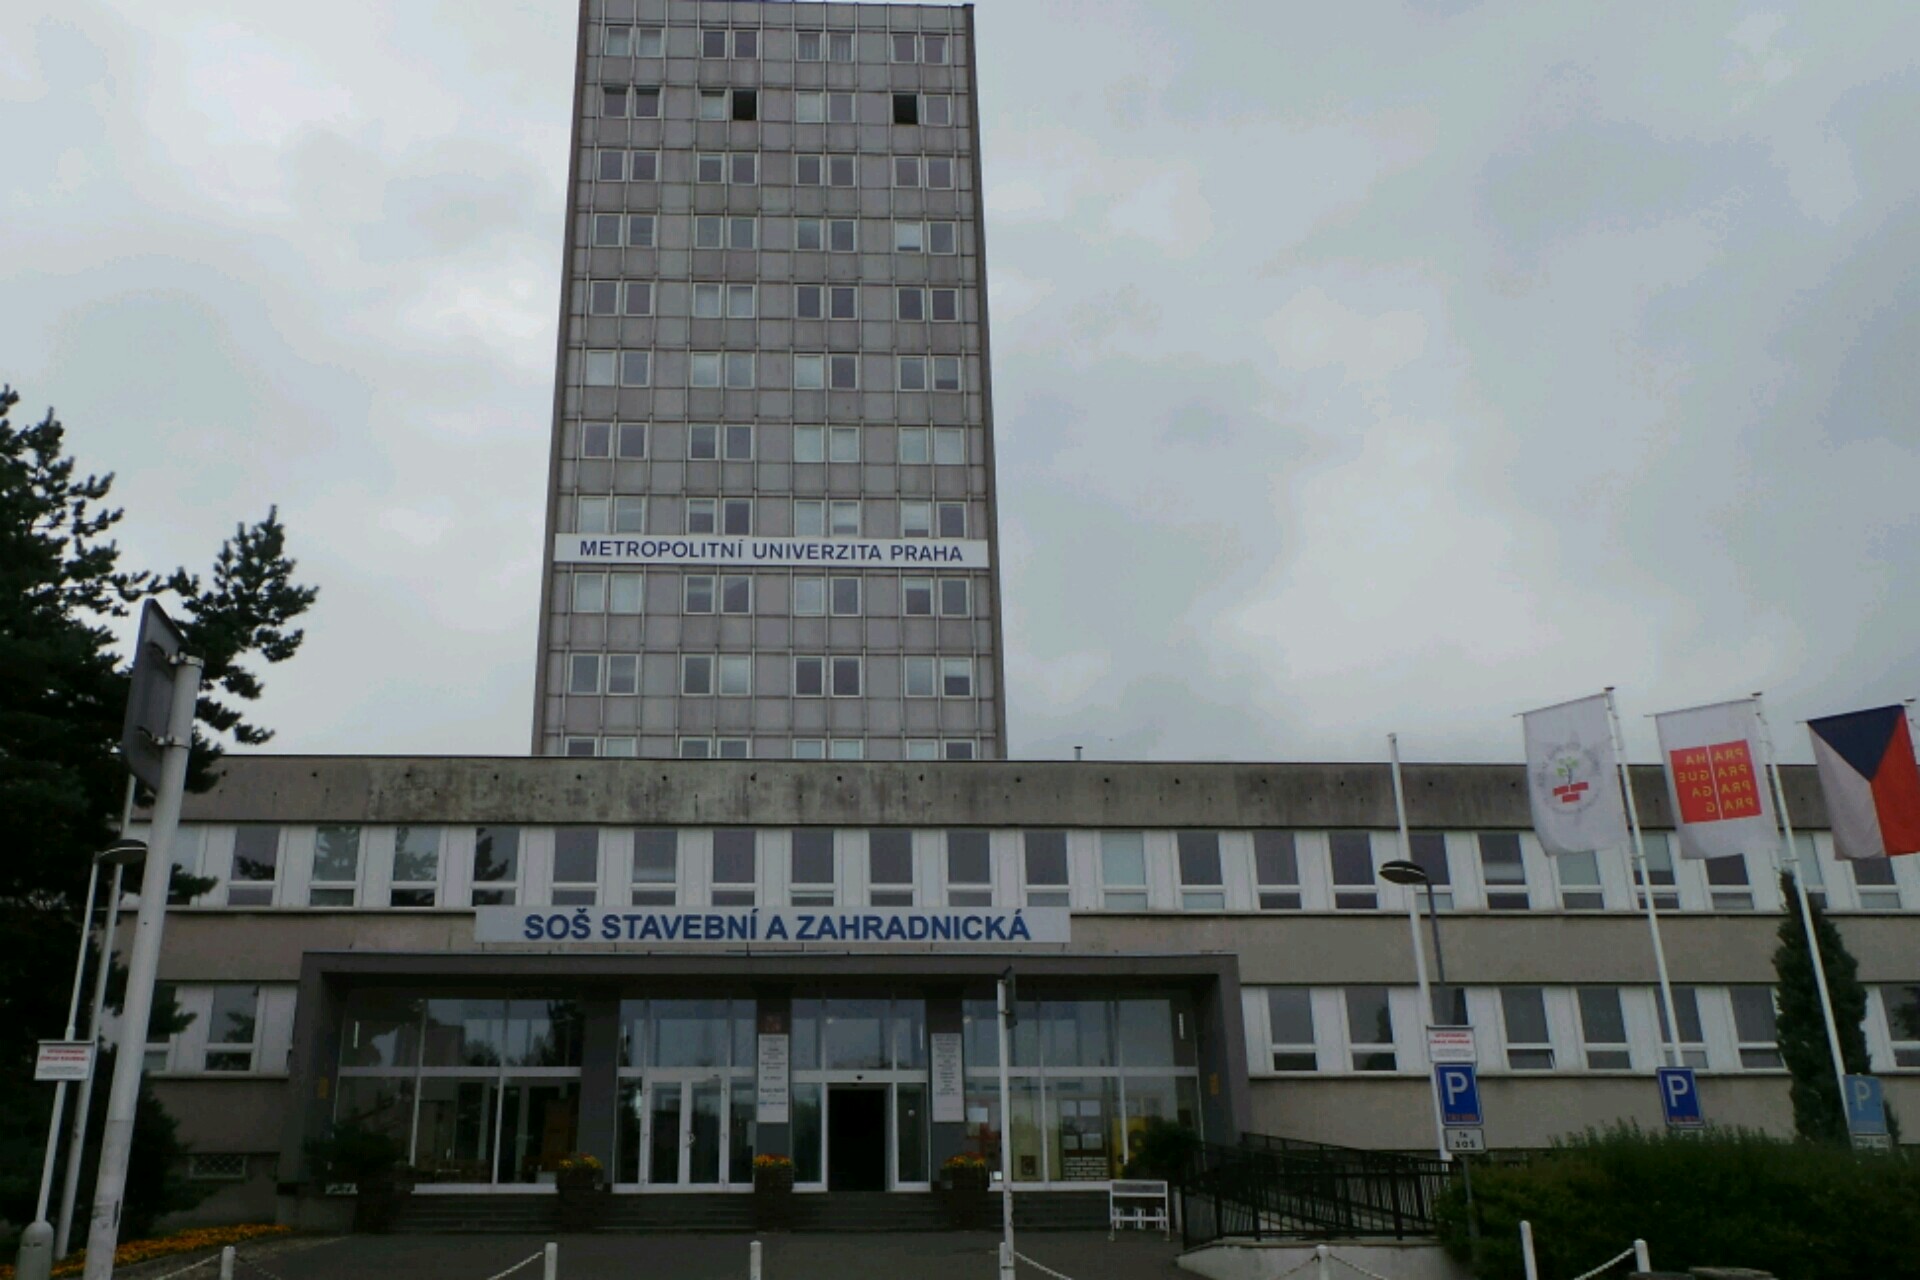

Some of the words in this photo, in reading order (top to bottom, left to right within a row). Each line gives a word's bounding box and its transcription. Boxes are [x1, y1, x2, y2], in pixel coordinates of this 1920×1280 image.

[579, 539, 744, 560] METROPOLITNÍ
[752, 543, 882, 561] UNIVERZITA
[890, 546, 964, 562] PRAHA
[523, 908, 592, 941] SOŠ
[601, 908, 760, 941] STAVEBNÍ
[765, 915, 790, 941] A
[795, 908, 1032, 942] ZAHRADNICKÁ
[1445, 1072, 1468, 1106] P
[1666, 1075, 1688, 1108] P
[1855, 1080, 1871, 1111] P
